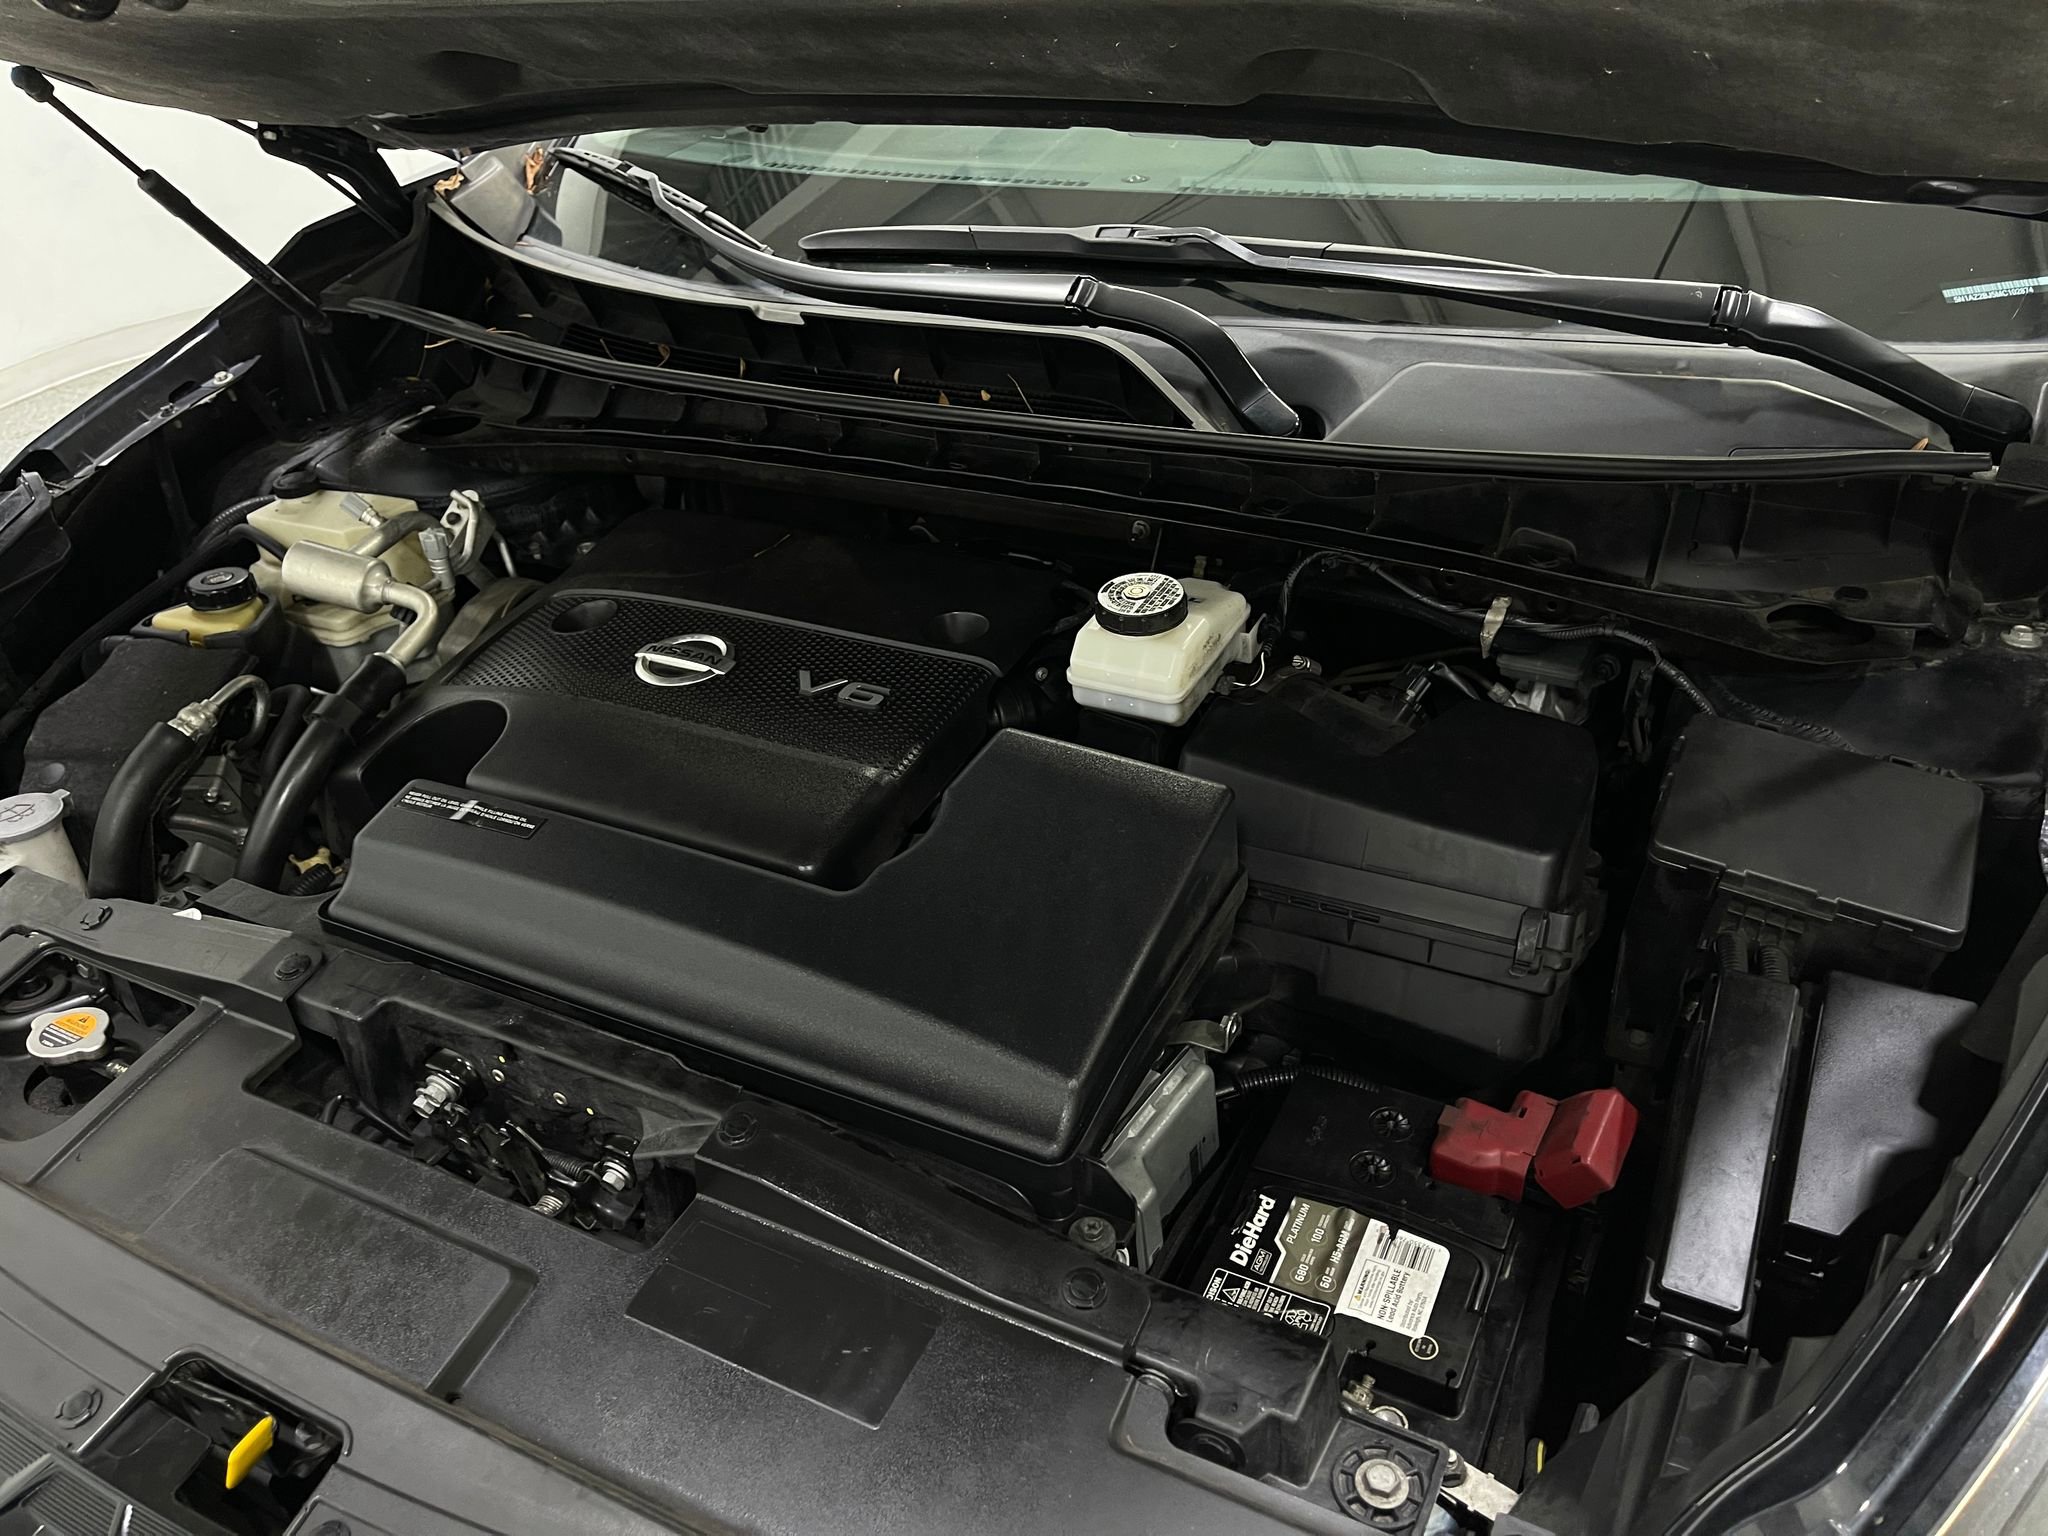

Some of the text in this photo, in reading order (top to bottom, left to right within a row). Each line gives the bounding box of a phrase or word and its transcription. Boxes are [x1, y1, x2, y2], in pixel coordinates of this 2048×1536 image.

[646, 644, 723, 666] NISSAN
[798, 669, 891, 709] V6
[1229, 1194, 1276, 1267] DieHard
[1286, 1203, 1311, 1245] PLATINUM
[1311, 1228, 1325, 1243] 100
[1253, 1250, 1267, 1270] AGM
[1294, 1264, 1310, 1282] 680
[1320, 1275, 1333, 1289] 60
[1206, 1277, 1222, 1301] OISON
[1377, 1269, 1401, 1320] NON-SPILLABLE
[1383, 1272, 1410, 1322] Lead Acid Battery
